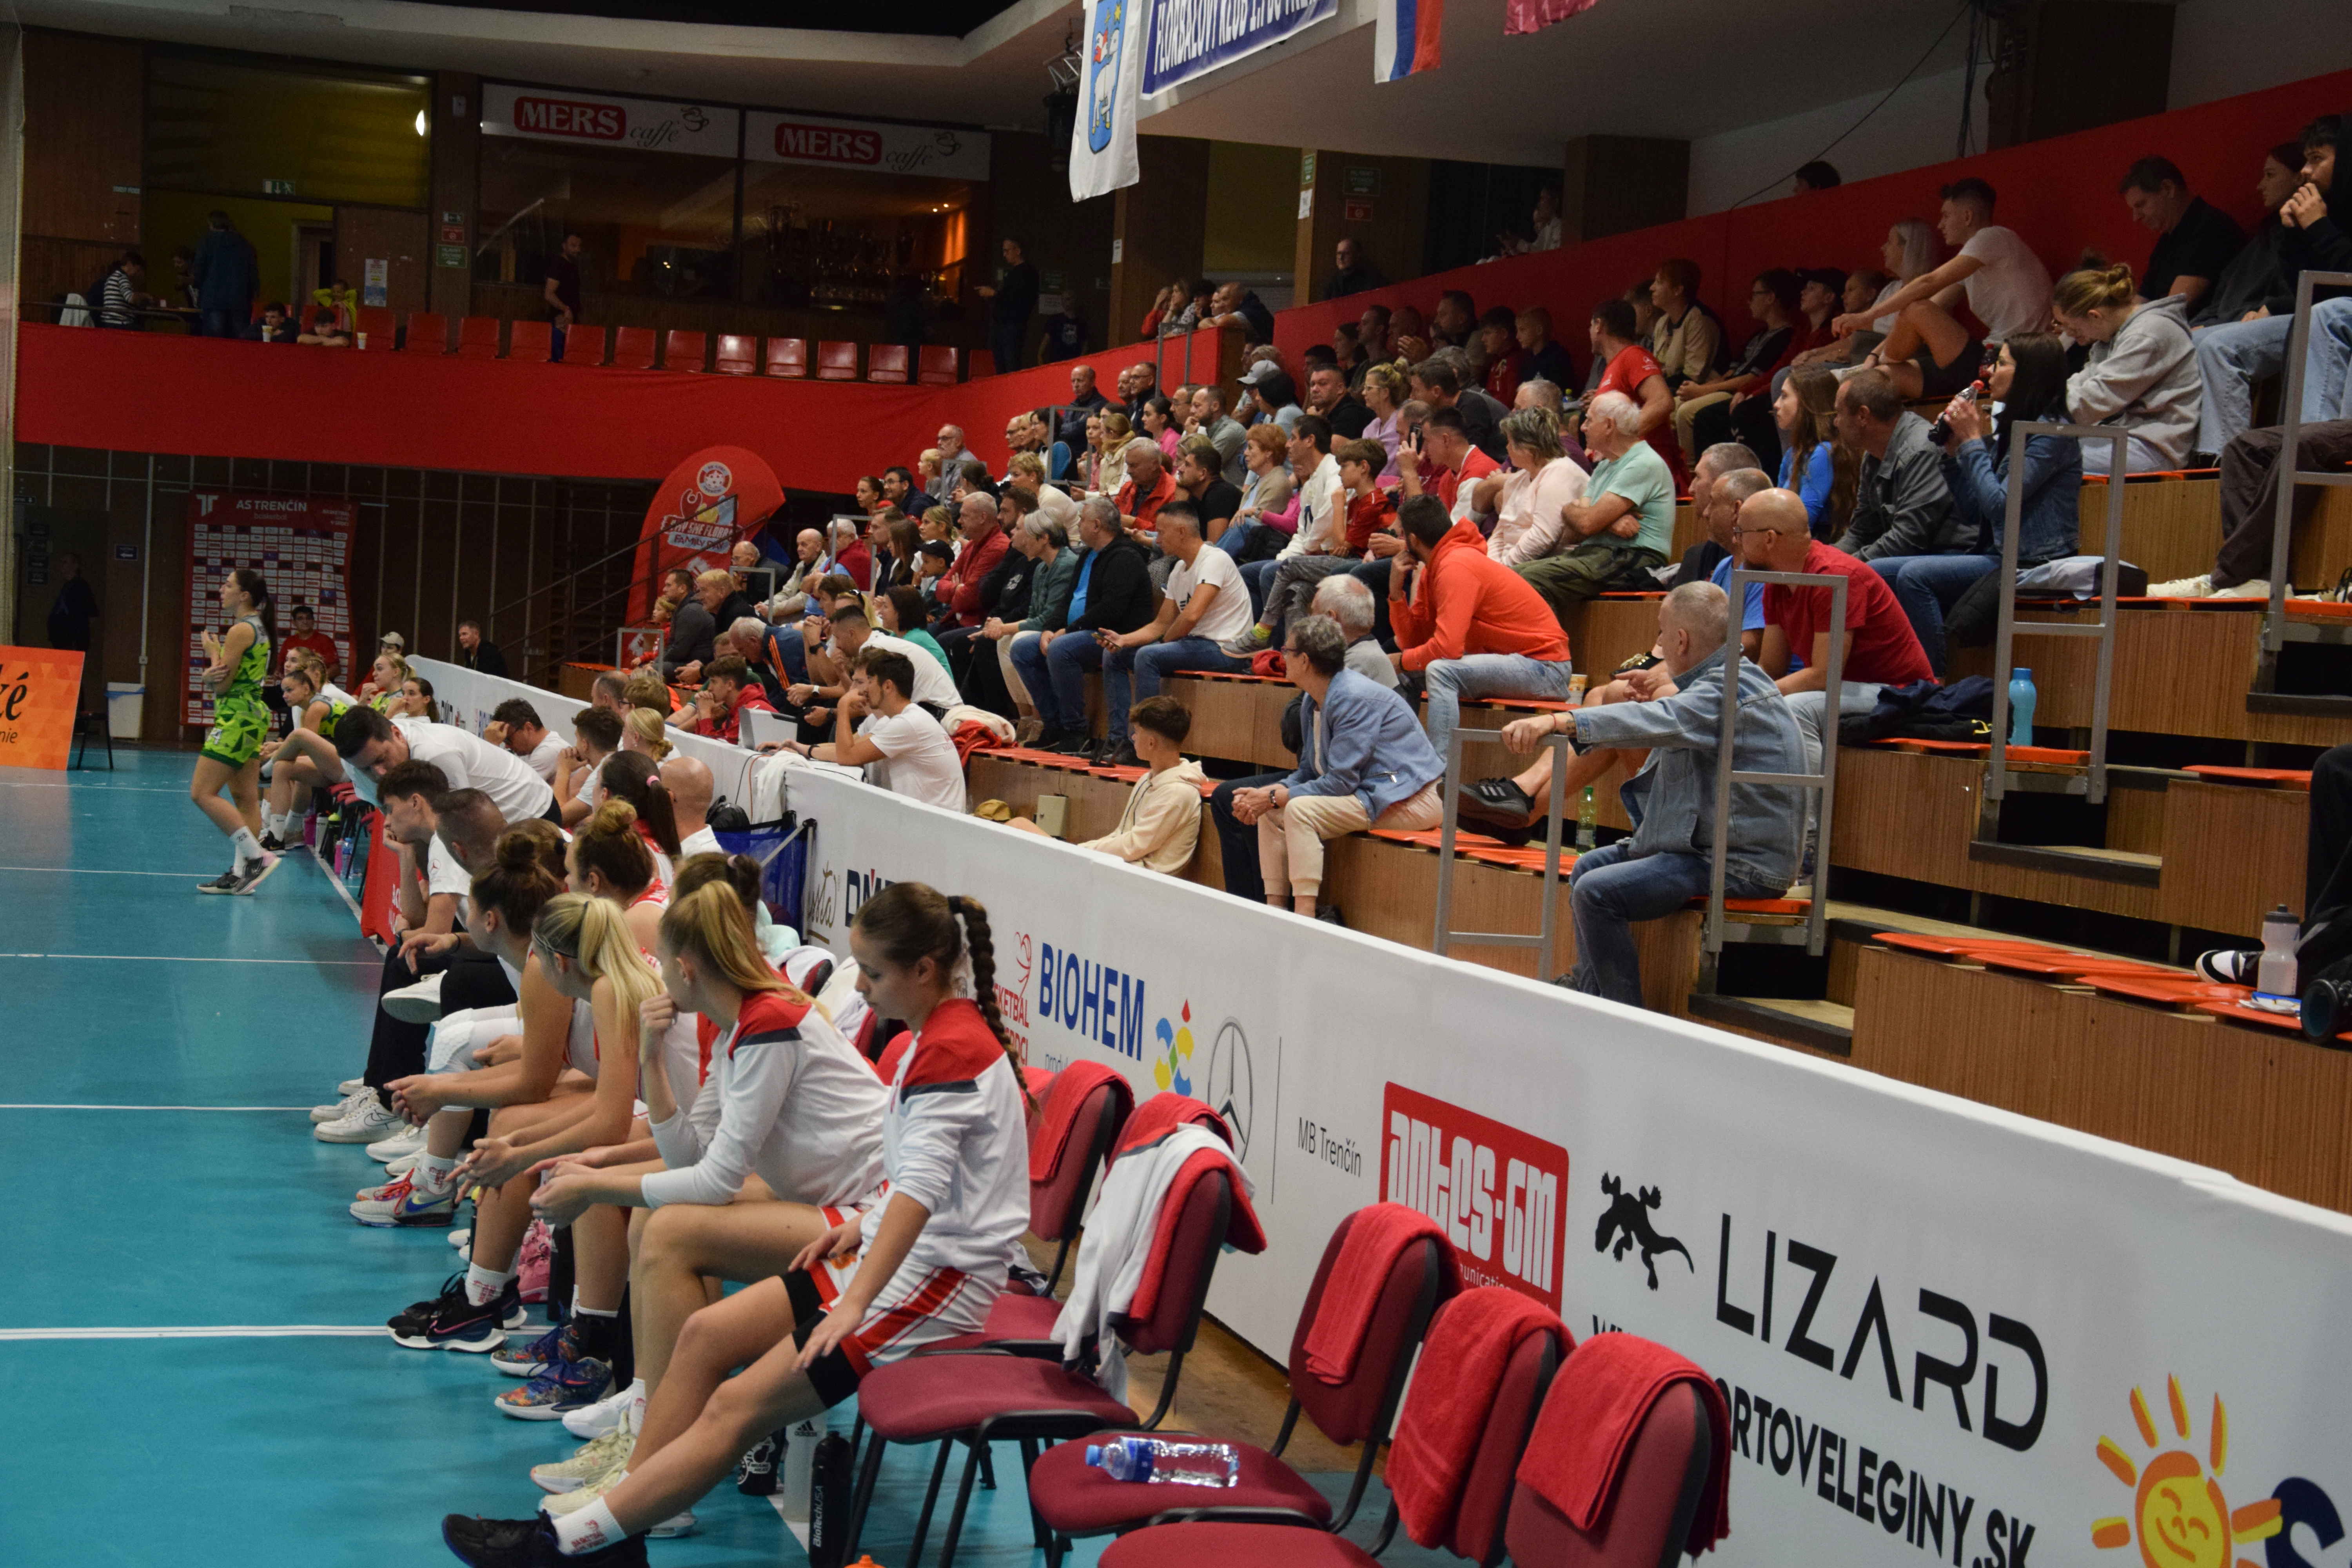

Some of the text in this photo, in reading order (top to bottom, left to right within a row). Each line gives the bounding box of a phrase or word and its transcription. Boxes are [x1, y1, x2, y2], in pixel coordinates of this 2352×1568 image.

[522, 102, 619, 136] MERS
[782, 128, 875, 160] MERS
[236, 499, 307, 512] AS TRENČÍN
[1039, 942, 1145, 1062] BIOHEM
[1298, 1117, 1362, 1177] MB Trenčín
[1716, 1212, 2049, 1452] LIZARD
[813, 1485, 824, 1548] BioTechUSA
